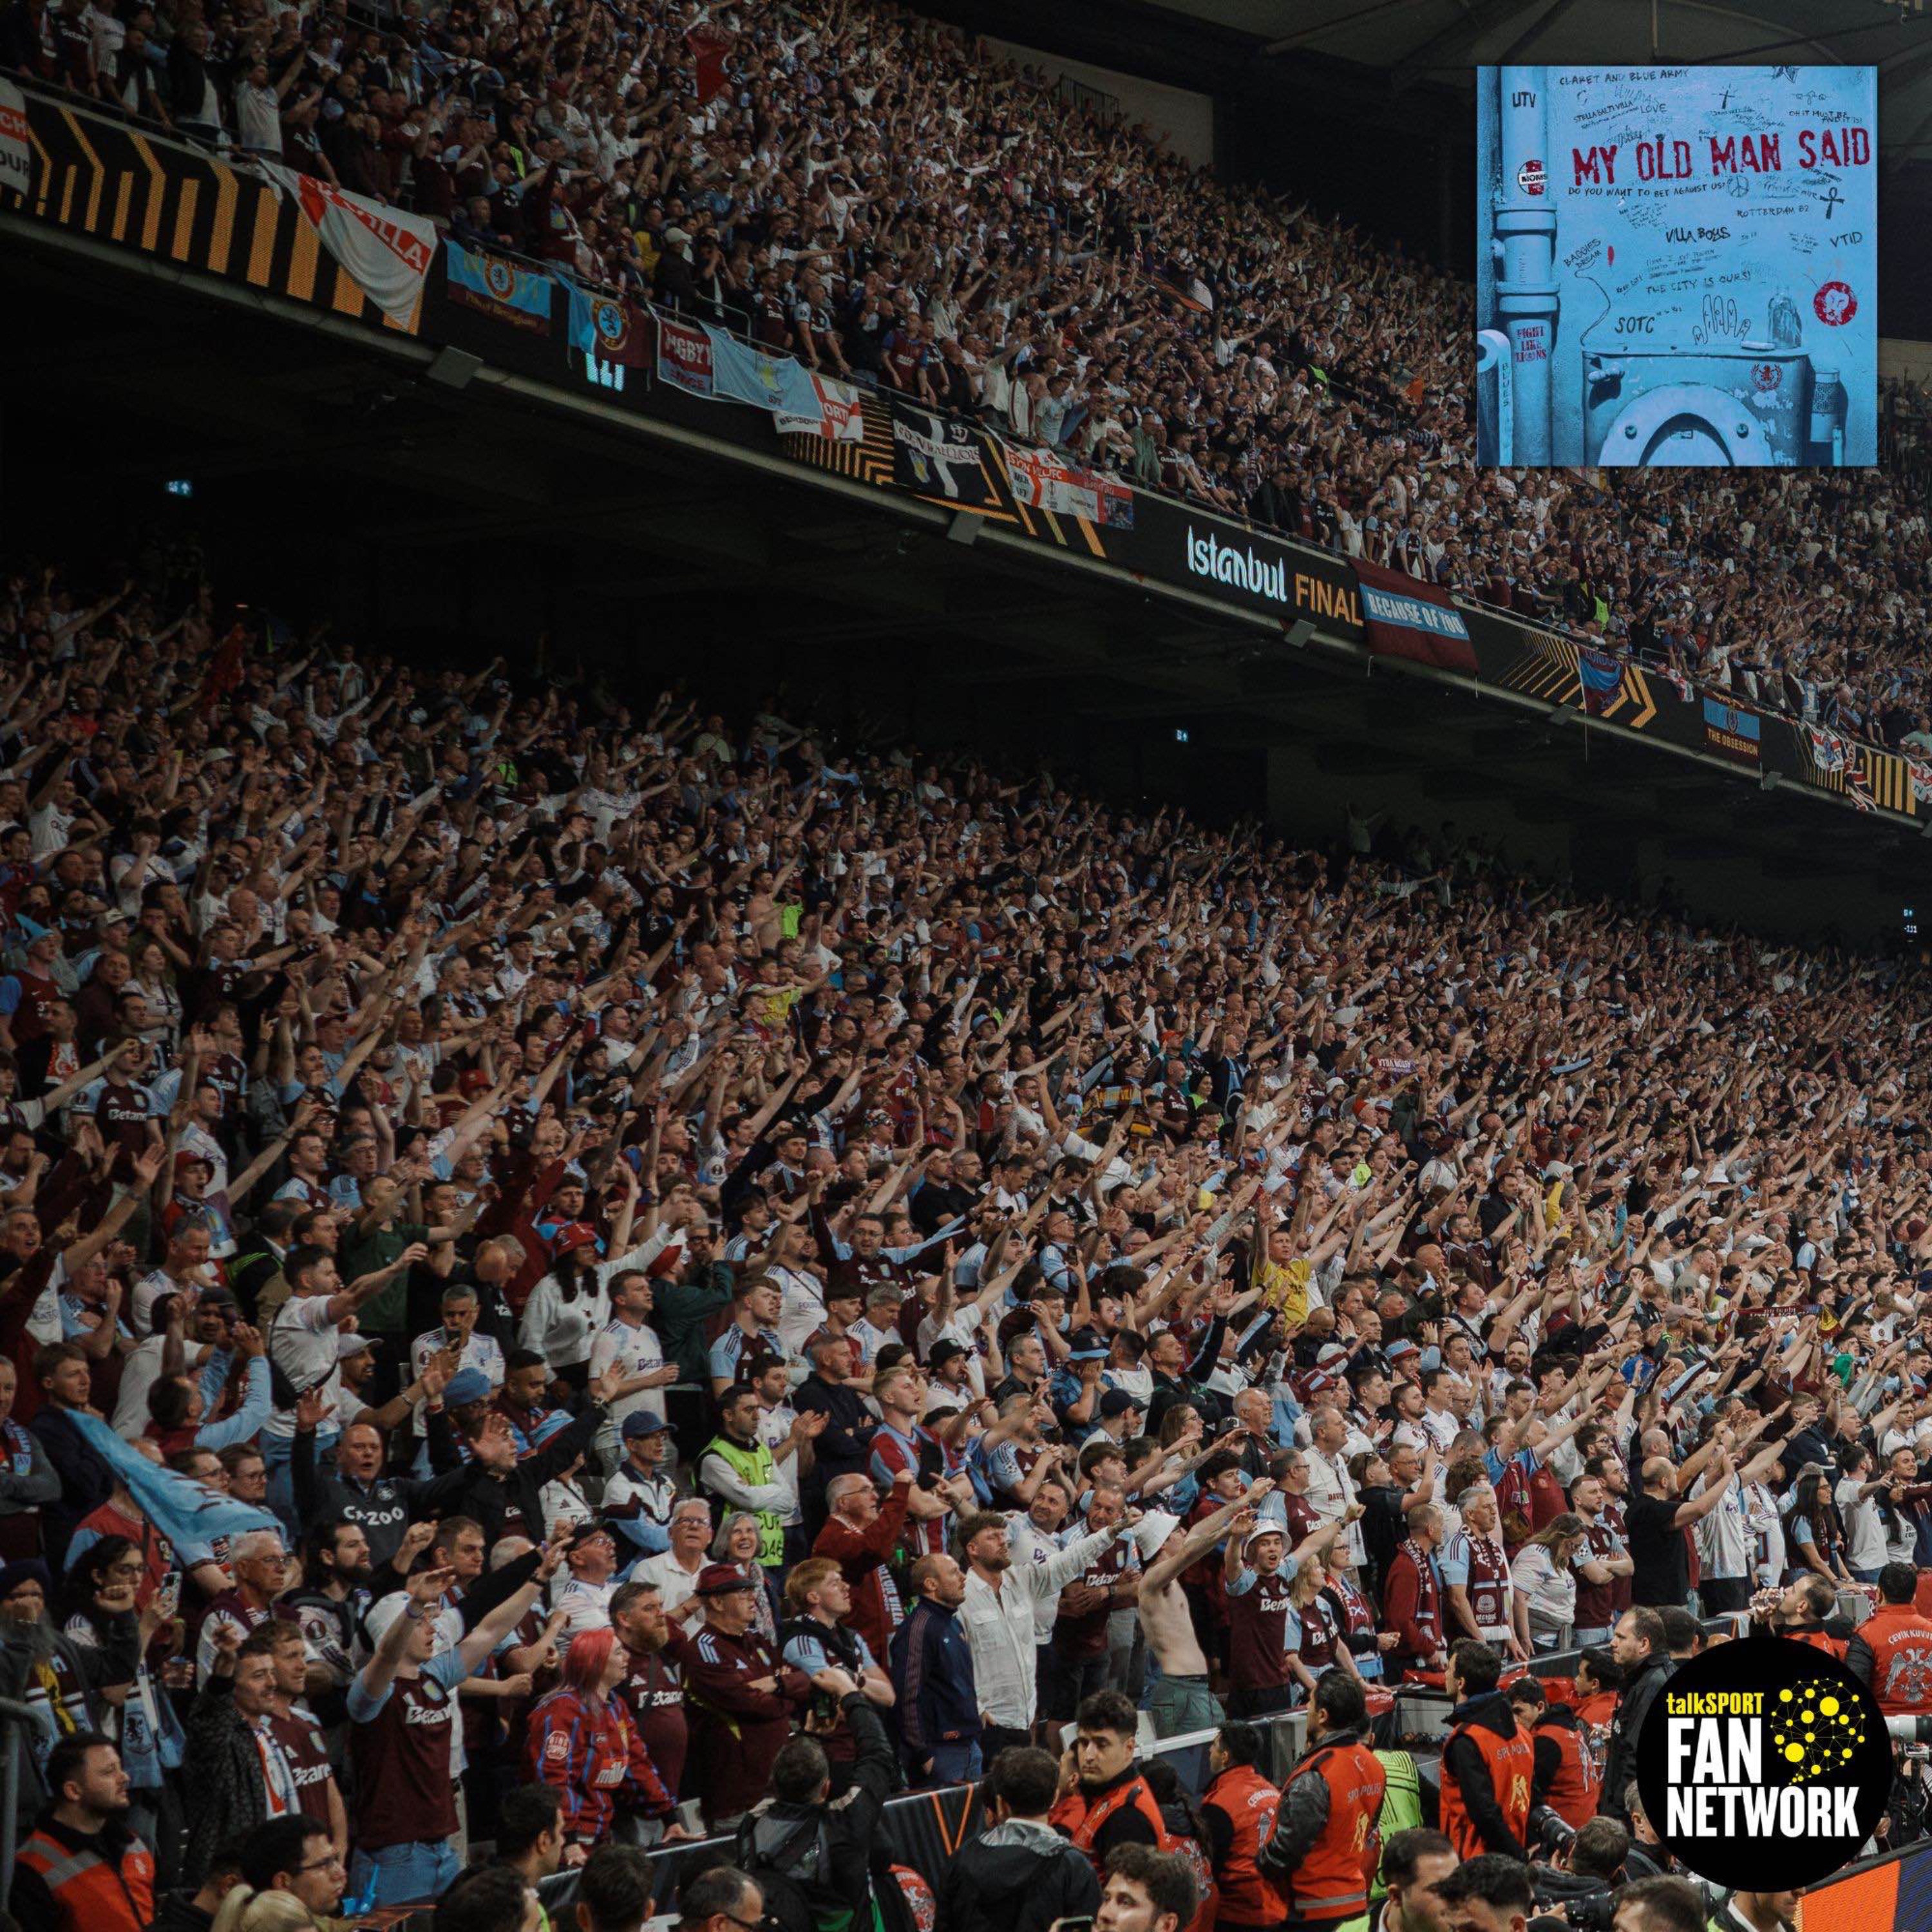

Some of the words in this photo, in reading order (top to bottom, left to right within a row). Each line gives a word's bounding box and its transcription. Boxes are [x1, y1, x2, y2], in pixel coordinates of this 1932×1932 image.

[1187, 525, 1287, 602] Istanbul
[1295, 573, 1364, 627] FINAL
[1367, 592, 1423, 625] BECAUSE
[1421, 606, 1439, 629] OF
[1439, 611, 1465, 635] YOU
[1707, 727, 1721, 743] THE
[1721, 734, 1759, 757] OBSESSION
